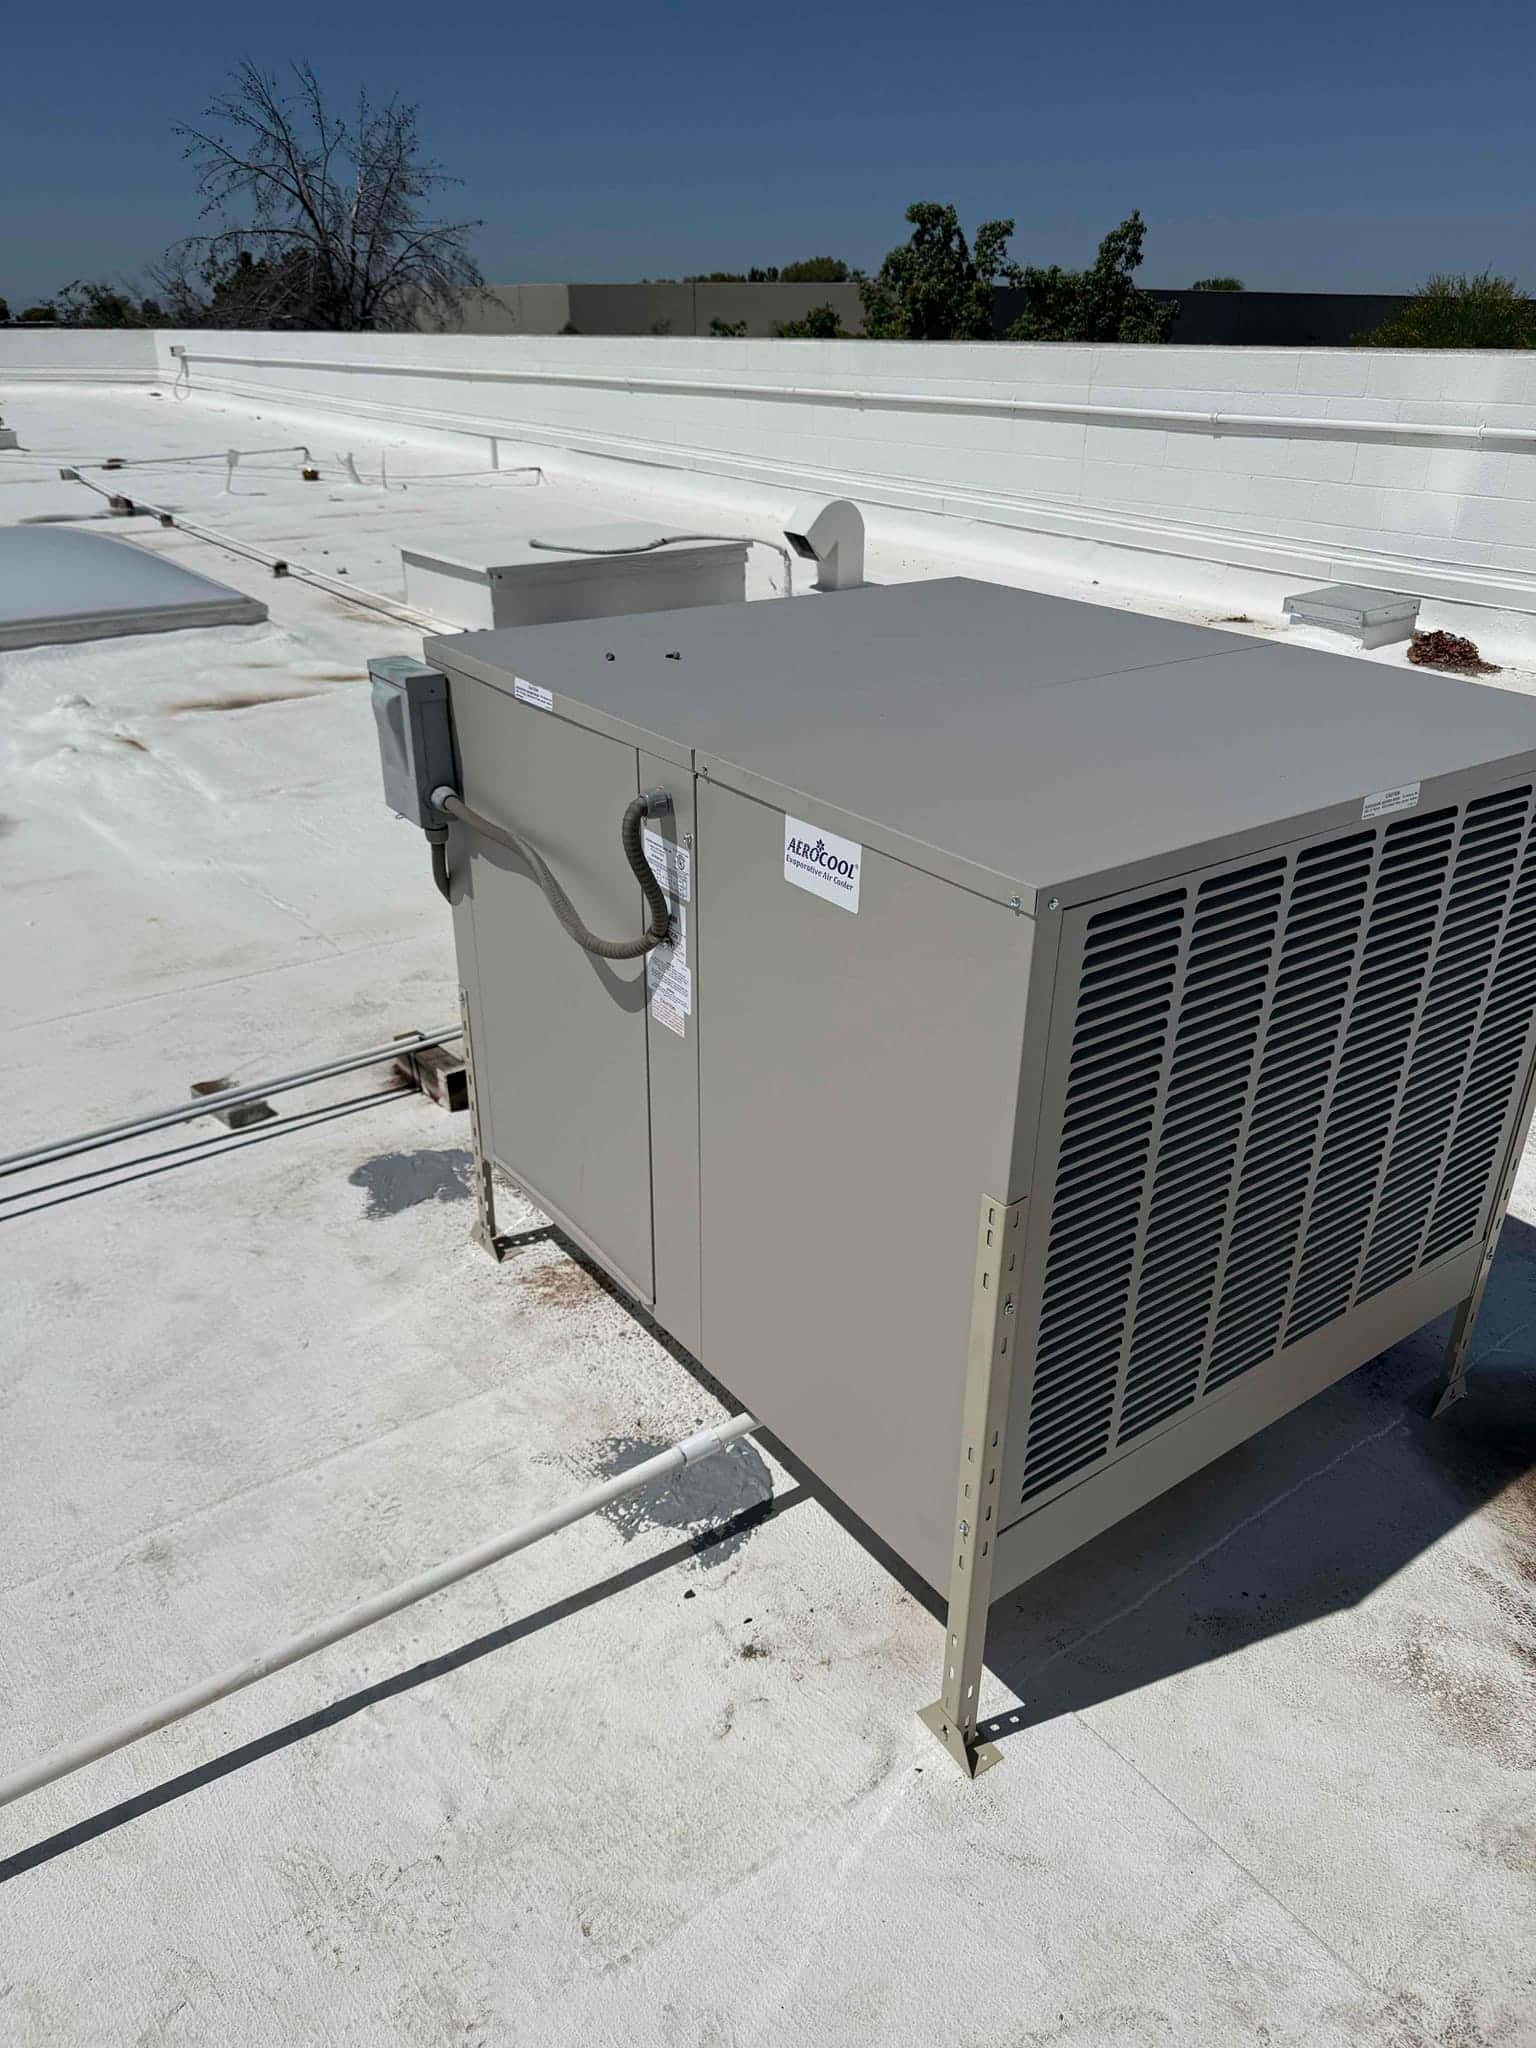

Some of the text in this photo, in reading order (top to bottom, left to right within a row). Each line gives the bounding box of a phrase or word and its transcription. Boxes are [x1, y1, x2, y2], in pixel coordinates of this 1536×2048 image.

[786, 854, 854, 892] Evaporative Air Cooler
[787, 838, 855, 880] AEROCOOL
